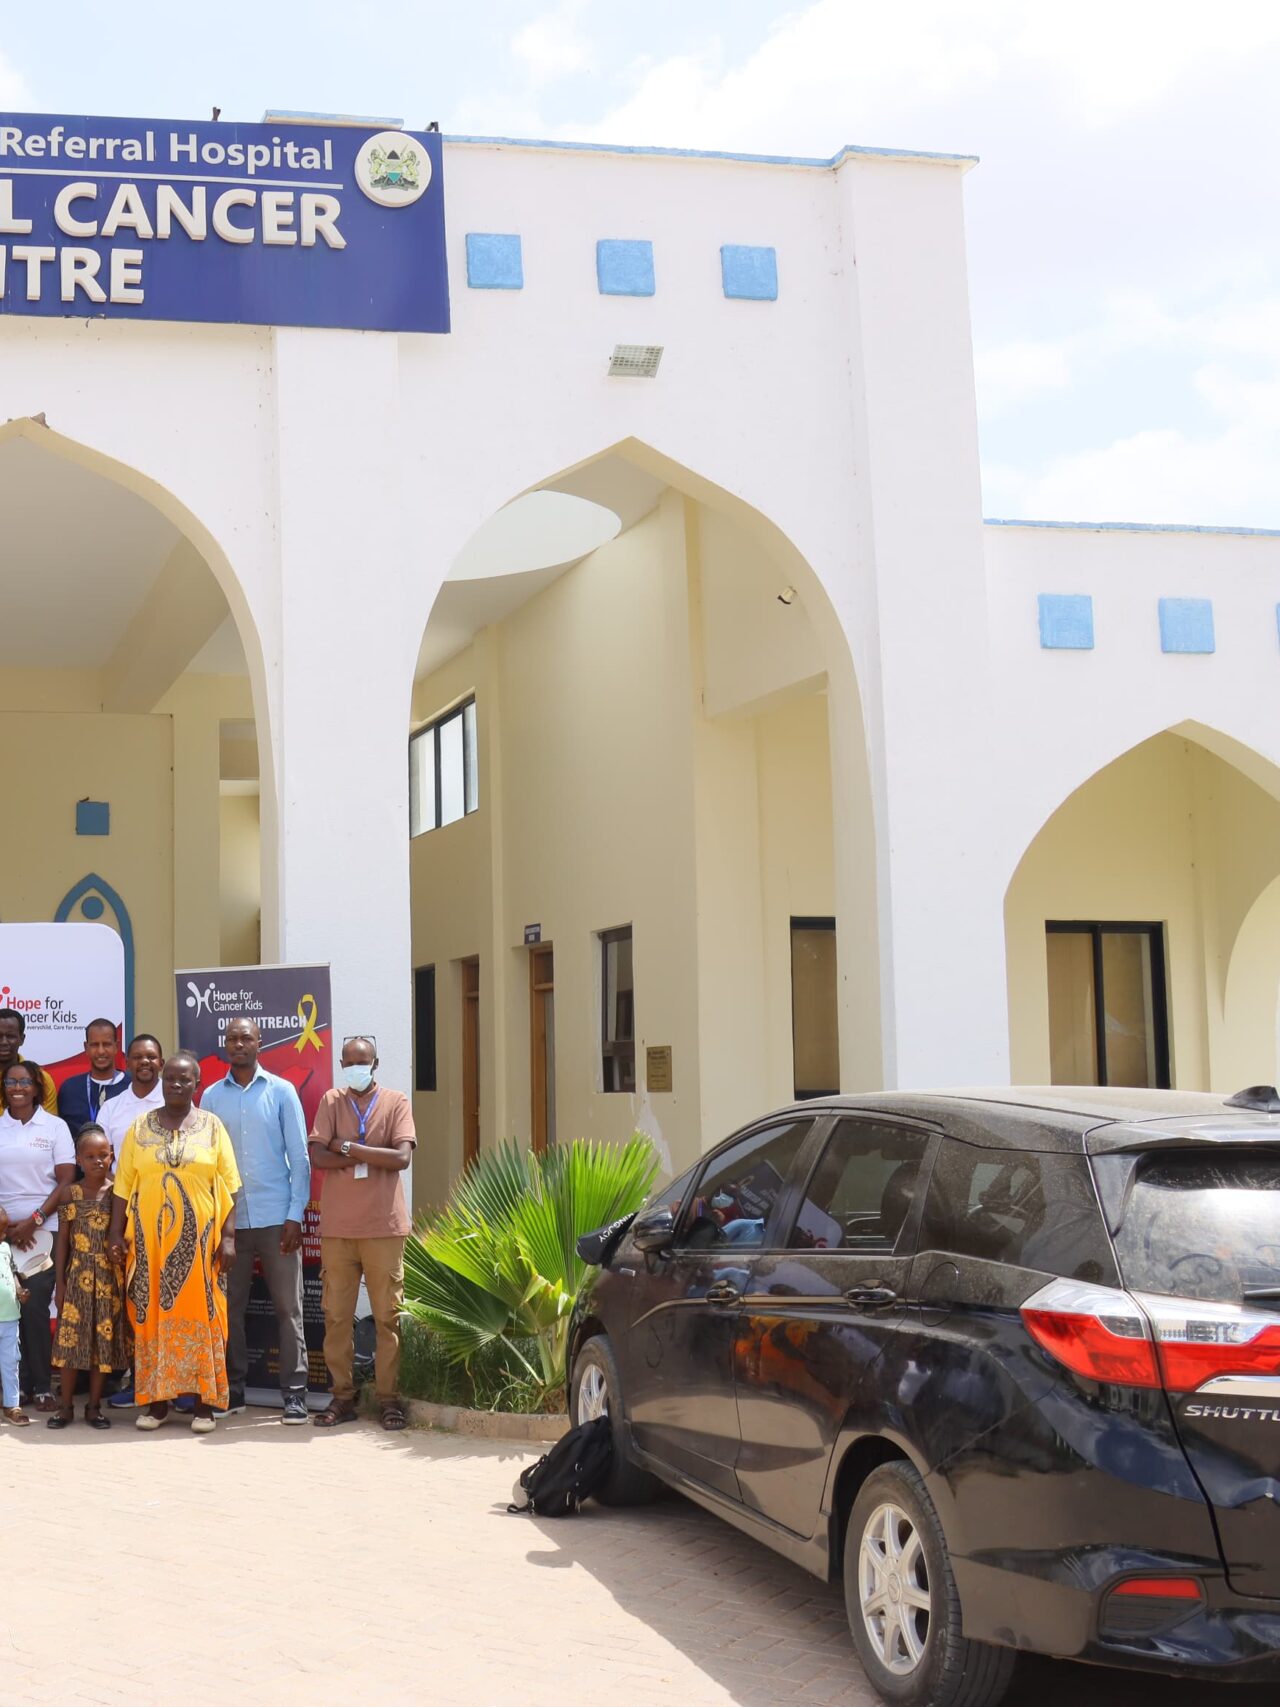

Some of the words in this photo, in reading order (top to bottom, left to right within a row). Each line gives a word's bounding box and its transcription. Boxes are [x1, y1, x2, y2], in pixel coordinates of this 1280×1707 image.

[0, 126, 157, 161] Referral
[170, 133, 334, 175] Hospital
[54, 182, 348, 250] CANCER
[213, 990, 238, 1002] Hope
[239, 989, 253, 1000] for
[7, 996, 41, 1011] Hope
[45, 996, 64, 1009] for
[213, 1001, 243, 1012] Cancer
[245, 1000, 263, 1011] Kids
[23, 1014, 49, 1023] ncer
[52, 1011, 77, 1023] Kids
[248, 1015, 306, 1030] UTREACH
[1184, 1404, 1280, 1421] SHUTTL
